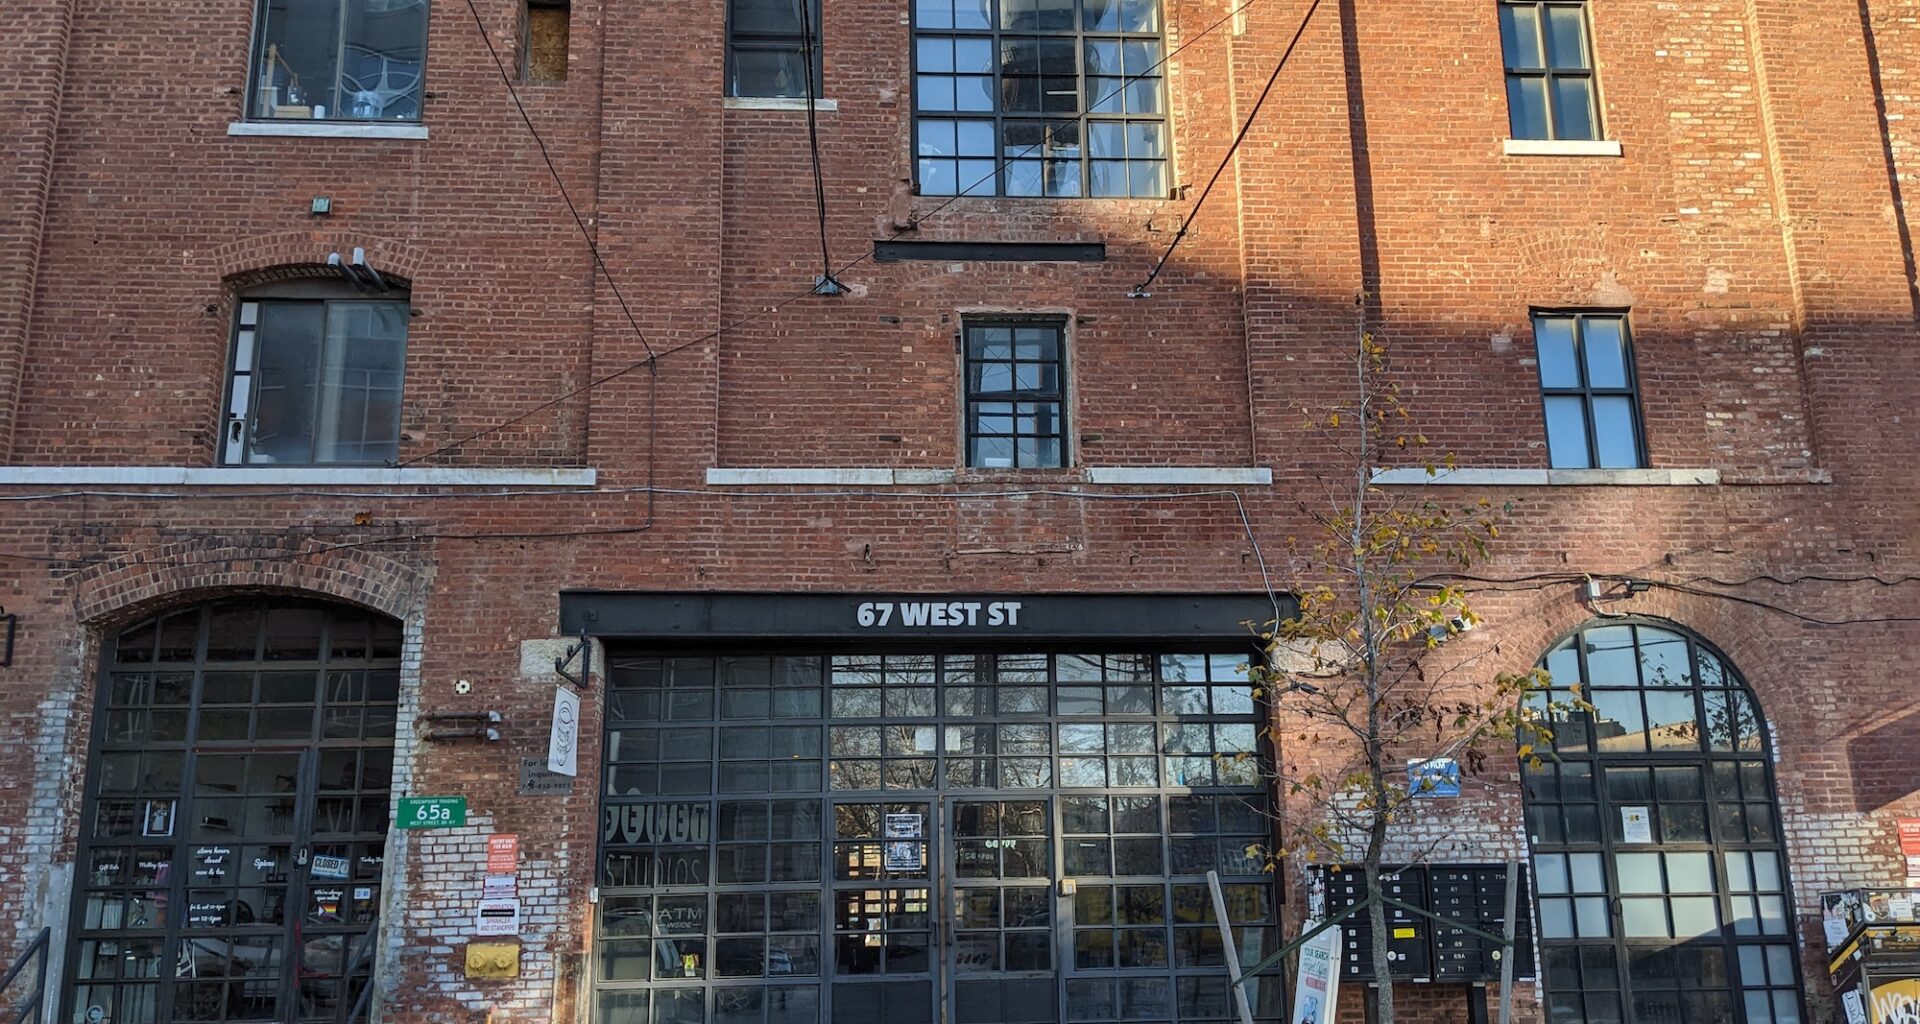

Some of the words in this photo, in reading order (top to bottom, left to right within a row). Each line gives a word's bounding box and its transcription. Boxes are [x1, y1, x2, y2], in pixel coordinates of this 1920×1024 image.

[857, 602, 894, 627] 67
[900, 602, 981, 626] WEST
[987, 602, 1022, 626] ST
[416, 804, 450, 820] 65a
[213, 846, 230, 854] hours
[204, 855, 222, 864] closed
[314, 857, 339, 870] CLOSED
[606, 854, 701, 886] STUDIOS
[658, 908, 702, 920] ATM
[480, 924, 491, 932] AND
[492, 924, 516, 932] STANDPIPE
[1314, 949, 1329, 960] SEARCH
